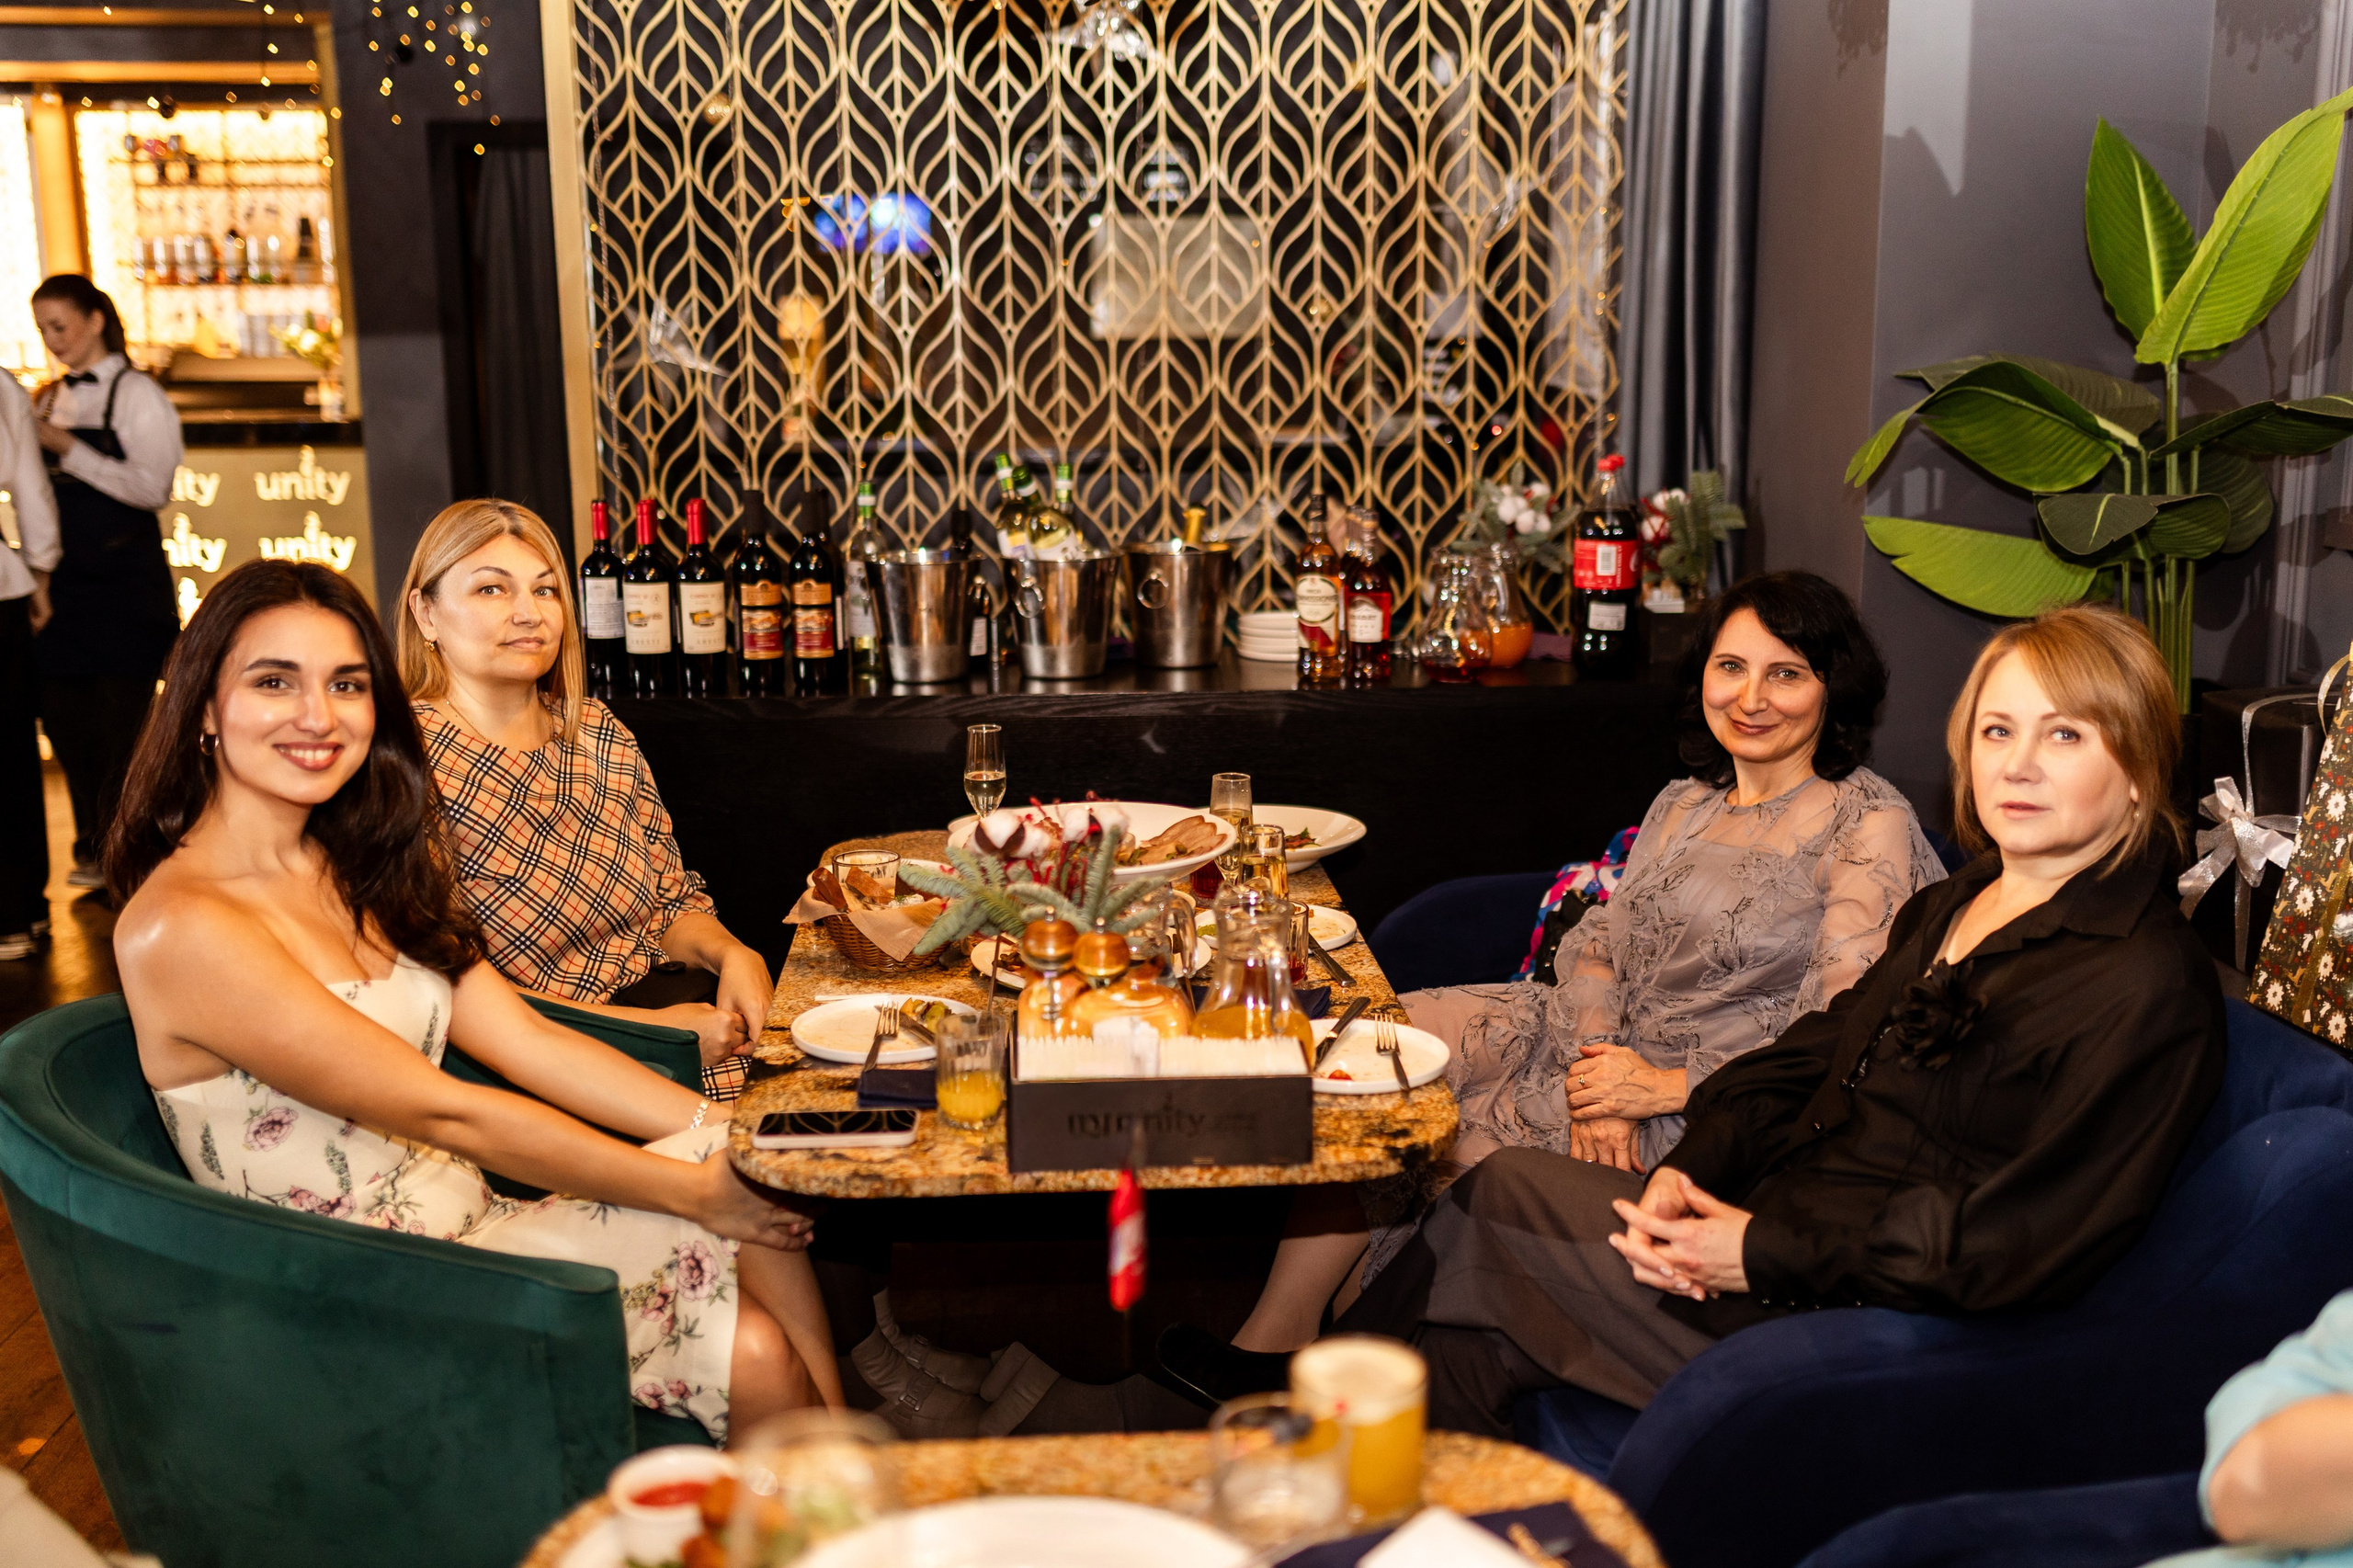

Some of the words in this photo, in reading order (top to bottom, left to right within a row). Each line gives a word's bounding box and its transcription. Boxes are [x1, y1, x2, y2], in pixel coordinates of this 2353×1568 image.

[170, 465, 221, 506] ity
[254, 445, 351, 506] unity
[258, 511, 358, 571] unity
